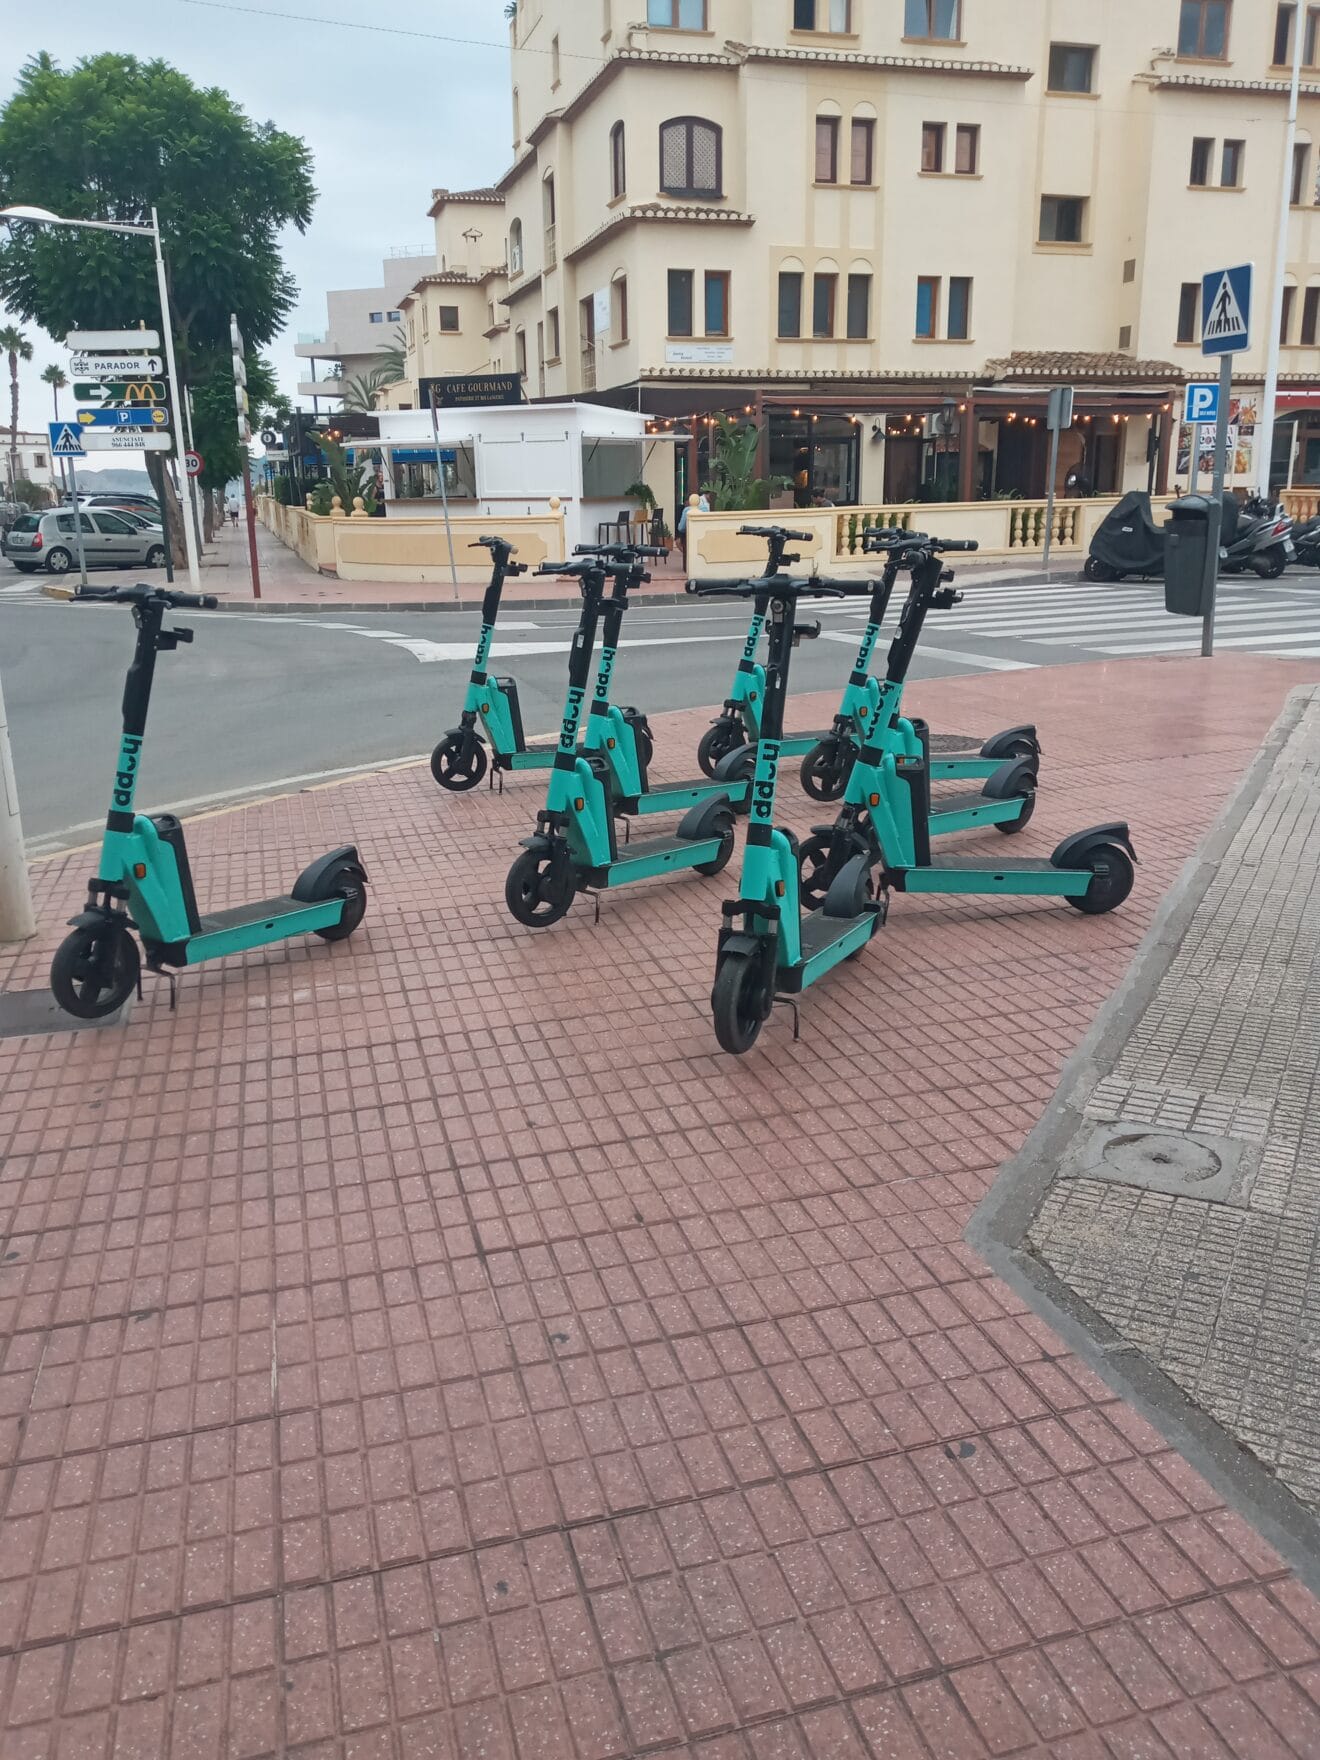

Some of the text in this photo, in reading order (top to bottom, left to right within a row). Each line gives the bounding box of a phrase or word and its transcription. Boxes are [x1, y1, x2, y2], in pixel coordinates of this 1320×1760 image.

[94, 362, 140, 370] PARADOR
[446, 383, 466, 393] CAFE
[467, 381, 513, 392] GOURMAND
[1192, 387, 1213, 418] P
